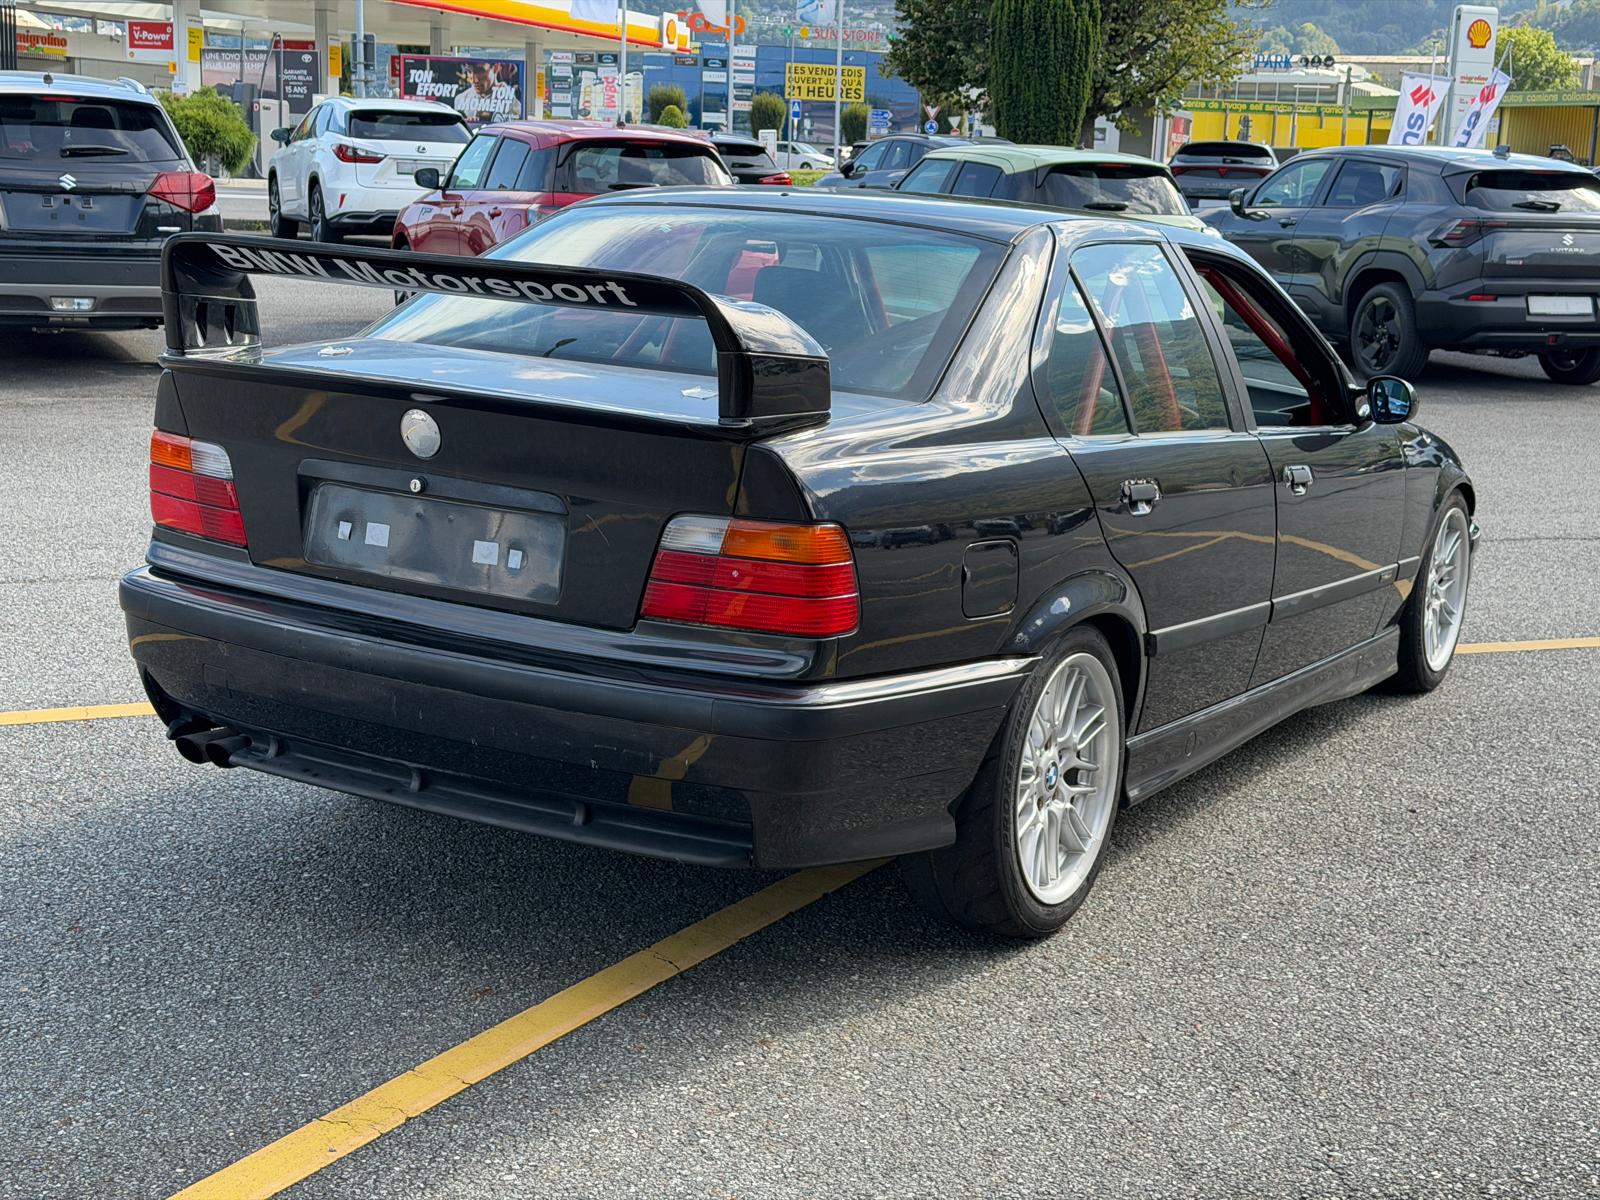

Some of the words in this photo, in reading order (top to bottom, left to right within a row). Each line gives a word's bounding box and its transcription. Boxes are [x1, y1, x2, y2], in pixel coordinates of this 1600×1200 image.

[16, 30, 67, 47] migrolino
[133, 31, 170, 40] V-Power
[815, 26, 838, 39] SUN
[843, 29, 880, 42] STORE
[205, 52, 220, 60] UNE
[1254, 53, 1293, 68] PARK
[409, 70, 433, 82] TON
[293, 86, 308, 94] ANS
[416, 83, 458, 97] EFFORT
[491, 87, 515, 99] TON
[458, 98, 513, 112] MOMENT
[207, 242, 331, 278] BMW
[331, 257, 638, 307] Motorsport
